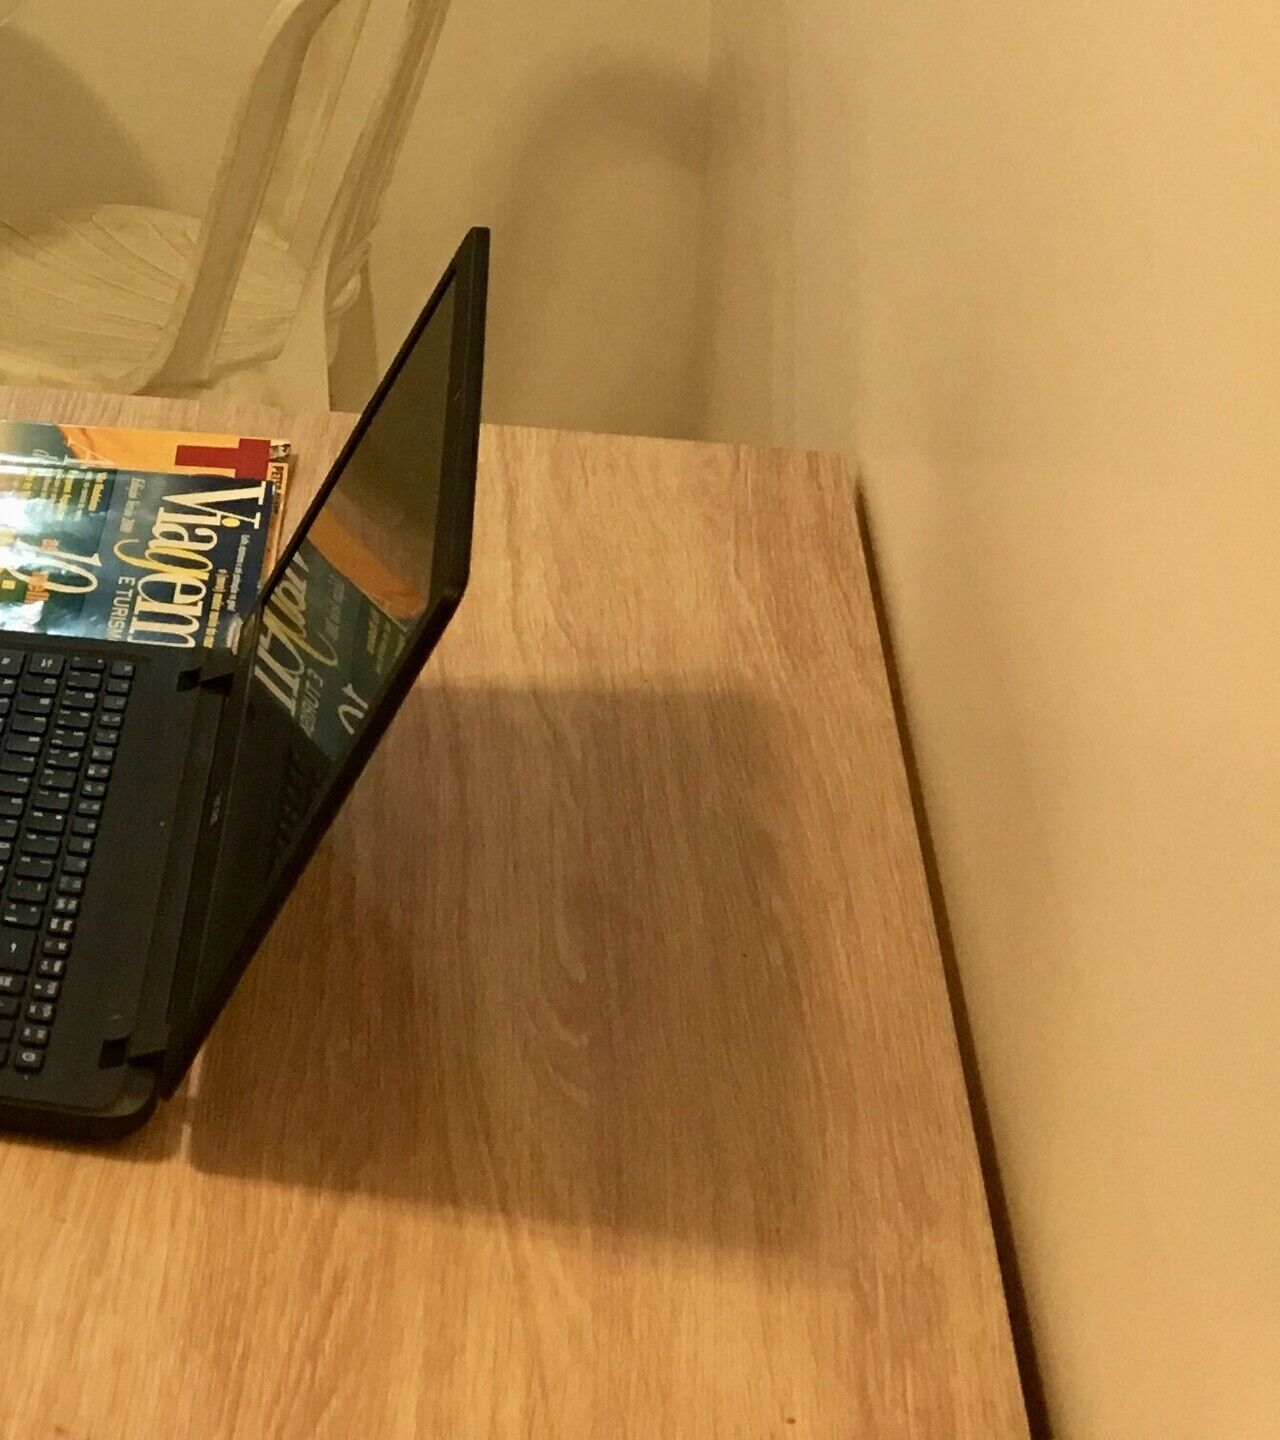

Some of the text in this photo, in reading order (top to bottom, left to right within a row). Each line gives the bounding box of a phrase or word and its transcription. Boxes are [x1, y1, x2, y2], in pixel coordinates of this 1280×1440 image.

[107, 575, 136, 641] E TURISM
[116, 480, 267, 648] Viagem
